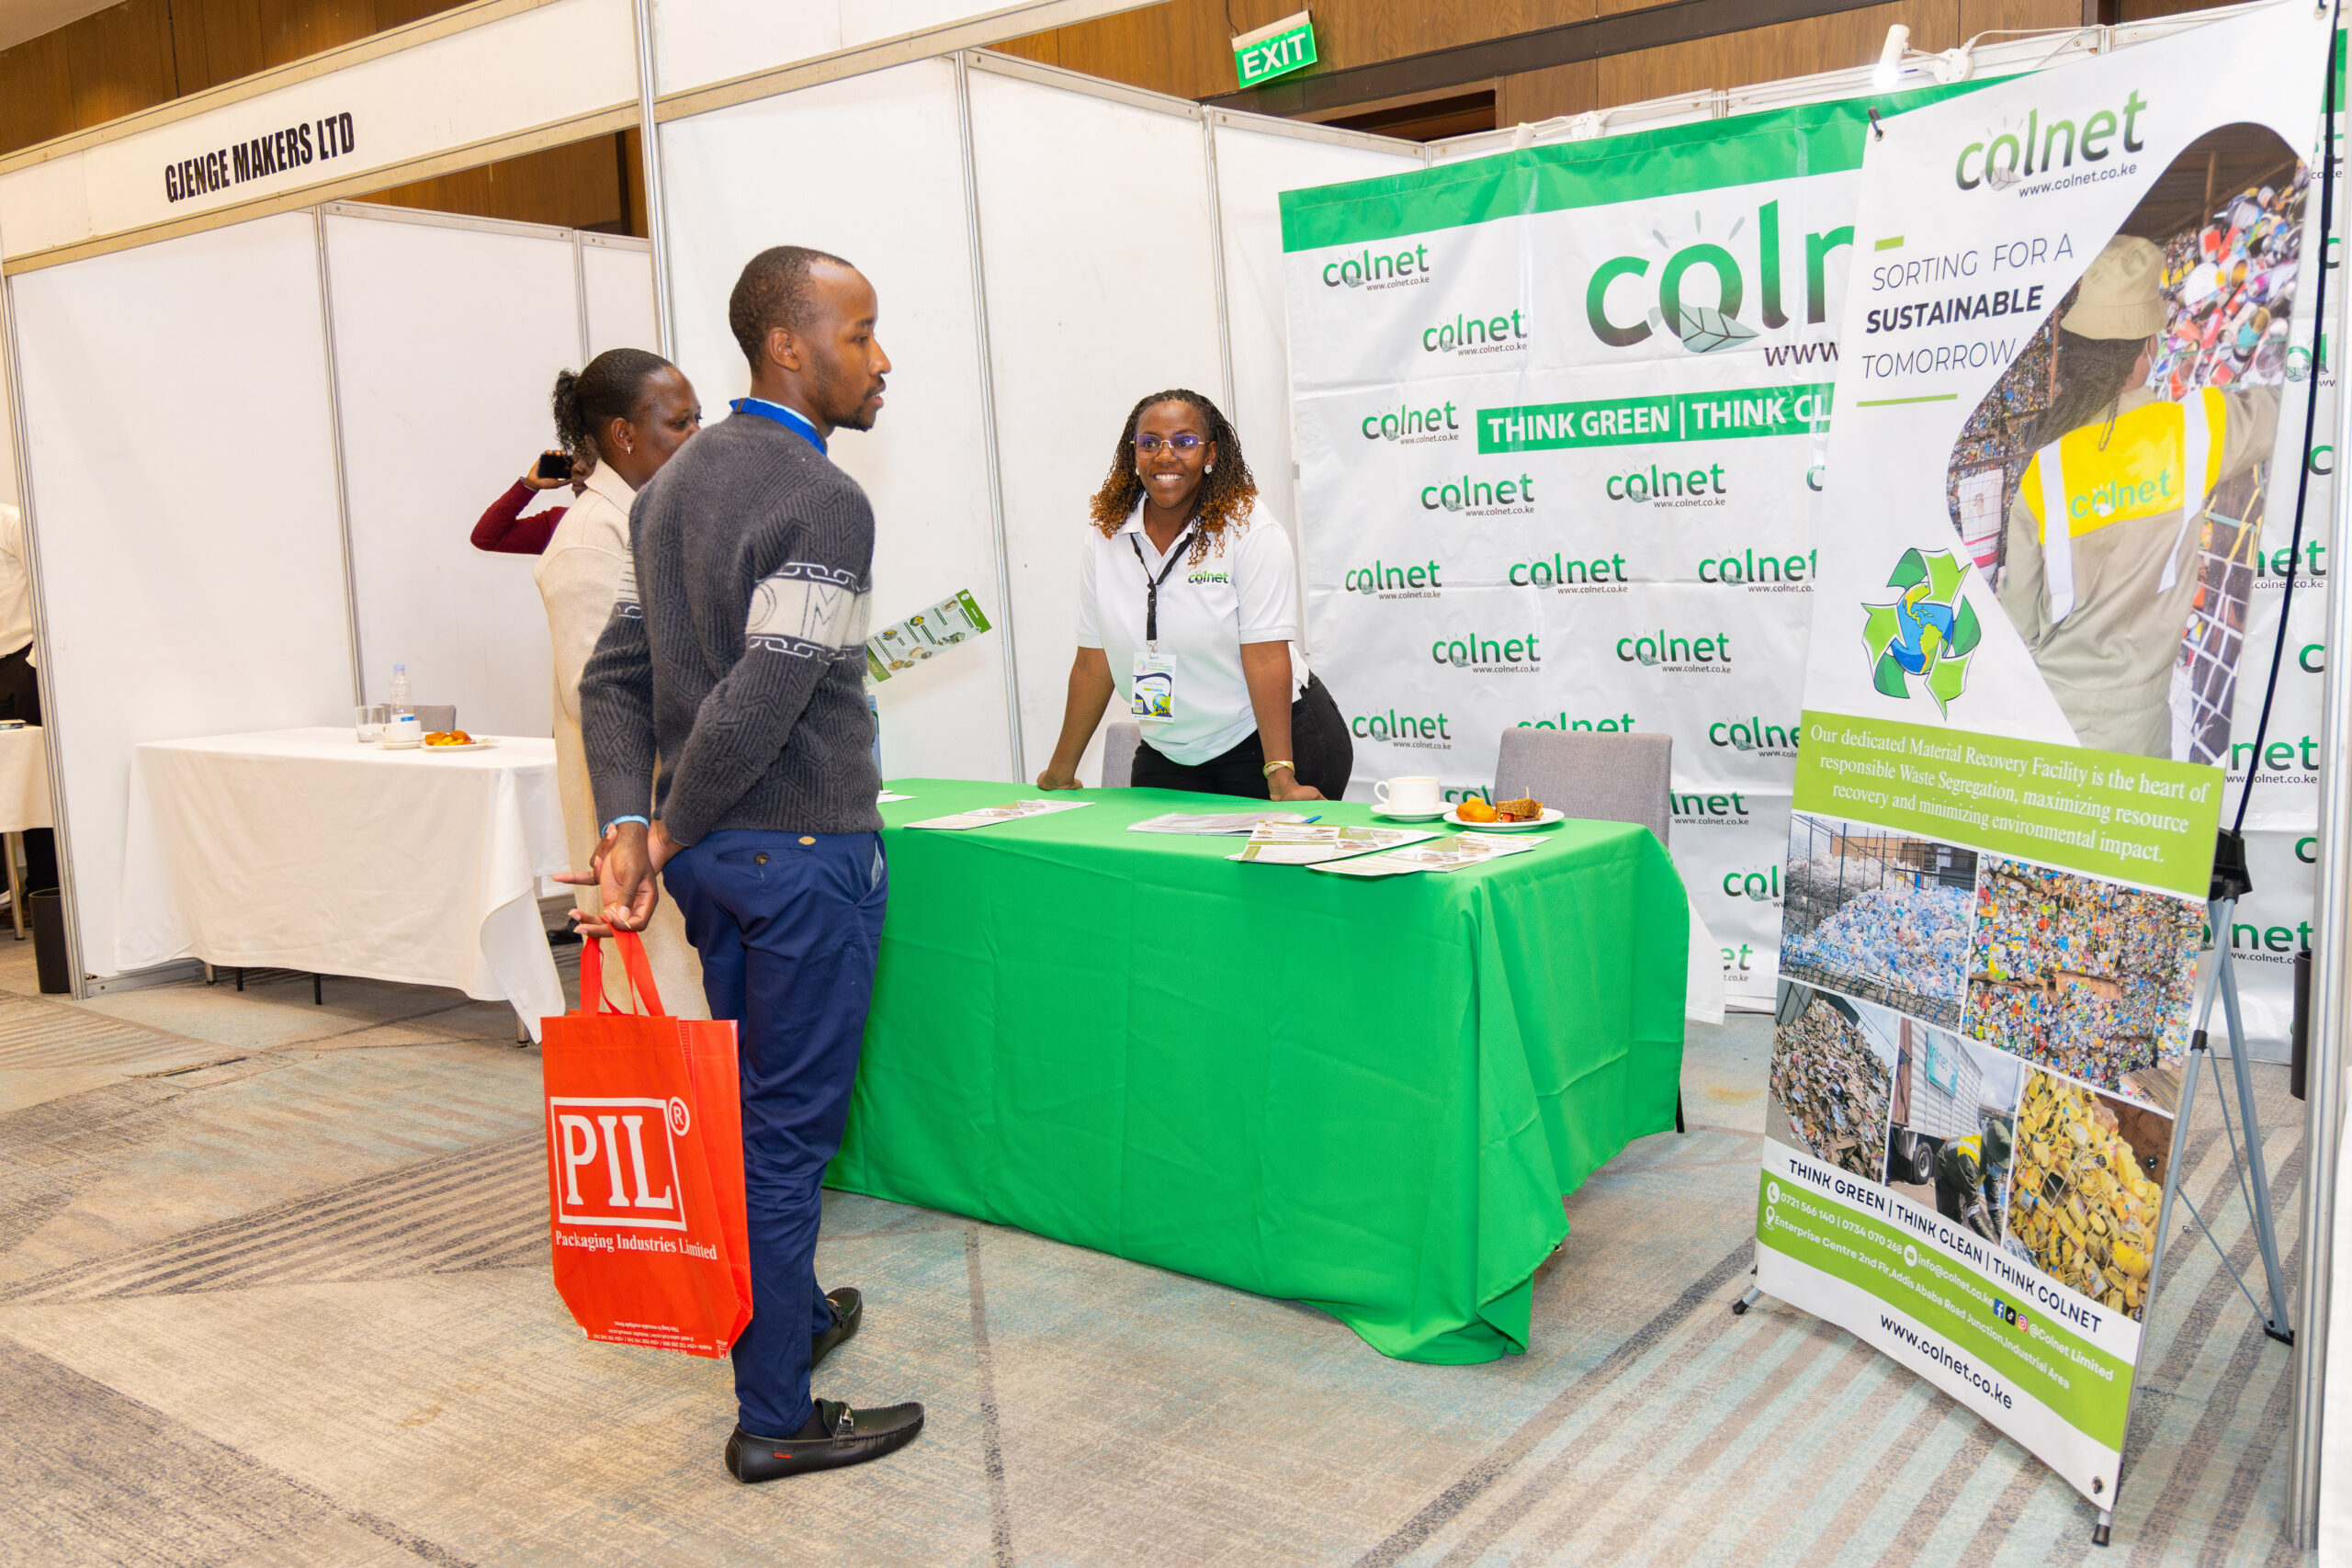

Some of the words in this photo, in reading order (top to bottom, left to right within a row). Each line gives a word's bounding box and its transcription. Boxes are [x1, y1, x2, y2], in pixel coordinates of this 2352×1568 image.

[1242, 32, 1306, 79] EXIT
[165, 149, 230, 203] GJENGE
[232, 122, 312, 184] MAKERS
[317, 111, 355, 161] LTD
[1956, 90, 2147, 190] colnet
[2018, 164, 2137, 197] www.colnet.co.ke
[1322, 243, 1430, 288] colnet
[1872, 251, 1978, 290] SORTING
[1994, 238, 2046, 272] FOR
[2054, 233, 2074, 261] A
[1366, 276, 1430, 291] www.colnet.co.ke
[1866, 285, 2044, 334] SUSTAINABLE
[1422, 309, 1528, 353] colnet
[1457, 342, 1528, 356] www.colnet.co.ke
[1862, 339, 2016, 379] TOMORROW
[1362, 400, 1459, 441] colnet
[1399, 433, 1459, 445] www.colnet.co.ke
[1488, 412, 1575, 443] THINK
[1581, 405, 1670, 435] GREEN
[1691, 398, 1787, 429] THINK
[1420, 473, 1534, 511] colnet
[1605, 463, 1726, 502] colnet
[2071, 468, 2170, 518] colnet
[1465, 504, 1534, 517] www.colnet.co.ke
[1654, 497, 1726, 510] www.colnet.co.ke
[1188, 570, 1229, 584] colnet
[1345, 560, 1442, 594] colnet
[1509, 553, 1628, 589] colnet
[1557, 582, 1628, 593] www.colnet.co.ke
[1748, 582, 1814, 592] www.colnet.co.
[1378, 589, 1442, 600] www.colnet.co.ke
[1432, 633, 1541, 665] colnet
[1616, 629, 1732, 662] colnet
[1472, 664, 1541, 674] www.colnet.co.ke
[1661, 663, 1732, 674] www.colnet.co.ke
[1351, 708, 1451, 739] colnet
[1393, 741, 1452, 750] www.colnet.co.ke
[1811, 725, 1838, 746] Our
[1841, 729, 1905, 753] dedicated
[1910, 739, 1962, 762] Material
[1965, 749, 2028, 776] Recovery
[2032, 758, 2087, 786] Facility
[2091, 769, 2103, 787] is
[2106, 769, 2134, 791] the
[2139, 774, 2186, 800] heart
[2189, 782, 2211, 805] of
[1670, 789, 1749, 816] lnet
[1820, 754, 1895, 779] responsible
[1900, 763, 1935, 785] Waste
[1939, 770, 2018, 805] Segregation,
[2023, 790, 2110, 823] maximizing
[2115, 805, 2188, 833] resource
[1674, 818, 1749, 826] www.colnet.co.ke
[1832, 783, 1889, 808] recovery
[1892, 791, 1916, 811] and
[1919, 795, 1988, 830] minimizing
[1992, 813, 2096, 849] environmental
[2099, 831, 2165, 863] impact.
[560, 1115, 673, 1209] PIL
[556, 1230, 614, 1252] Packaging
[616, 1234, 676, 1253] Industries
[679, 1237, 718, 1260] Limited
[1789, 1159, 1831, 1190] THINK
[1835, 1179, 1884, 1212] GREEN
[1896, 1204, 1937, 1238] THINK
[1939, 1228, 1983, 1265] CLEAN
[1993, 1258, 2035, 1296] THINK
[2038, 1286, 2102, 1333] COLNET
[1775, 1215, 1820, 1244] Enterprise
[1823, 1236, 1858, 1258] Centre
[1859, 1252, 1877, 1269] 2nd
[1916, 1282, 1942, 1306] Ababa
[1944, 1299, 1966, 1320] Road
[2048, 1367, 2069, 1389] Area
[1781, 1192, 1800, 1209] 0721
[1801, 1202, 1817, 1216] 566
[1819, 1210, 1836, 1224] 140
[1842, 1220, 1866, 1236] 0734
[1868, 1230, 1886, 1245] 070
[1887, 1239, 1903, 1255] 268
[1918, 1254, 1994, 1307] info@colnet.co.ke
[2029, 1323, 2069, 1357] @Colnet
[2071, 1349, 2114, 1382] Limited
[1880, 1314, 2013, 1410] www.colnet.co.ke
